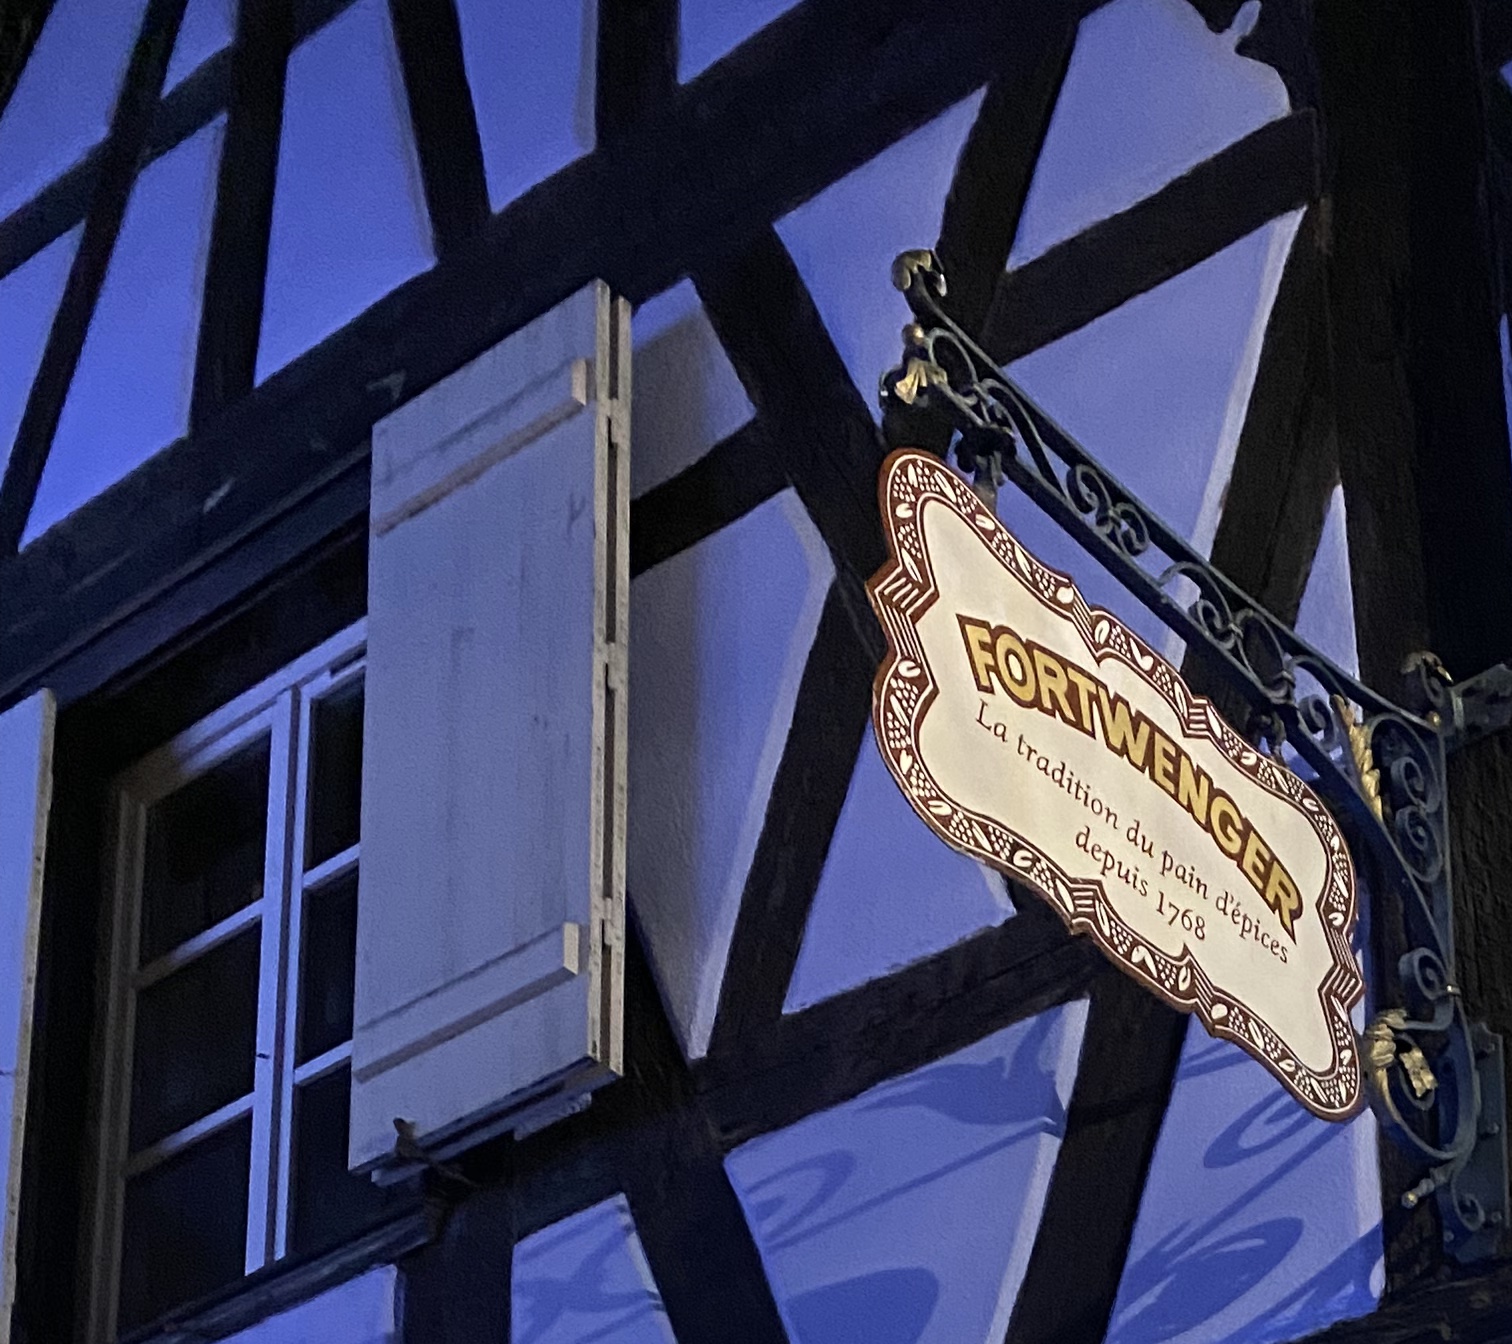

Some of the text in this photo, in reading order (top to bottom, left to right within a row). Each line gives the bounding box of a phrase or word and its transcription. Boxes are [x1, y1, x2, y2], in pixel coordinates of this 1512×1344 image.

[955, 614, 1301, 944] FORTWENGER
[976, 701, 1290, 964] La tradition du pain d'épices
[1075, 826, 1207, 940] depuis 1768
